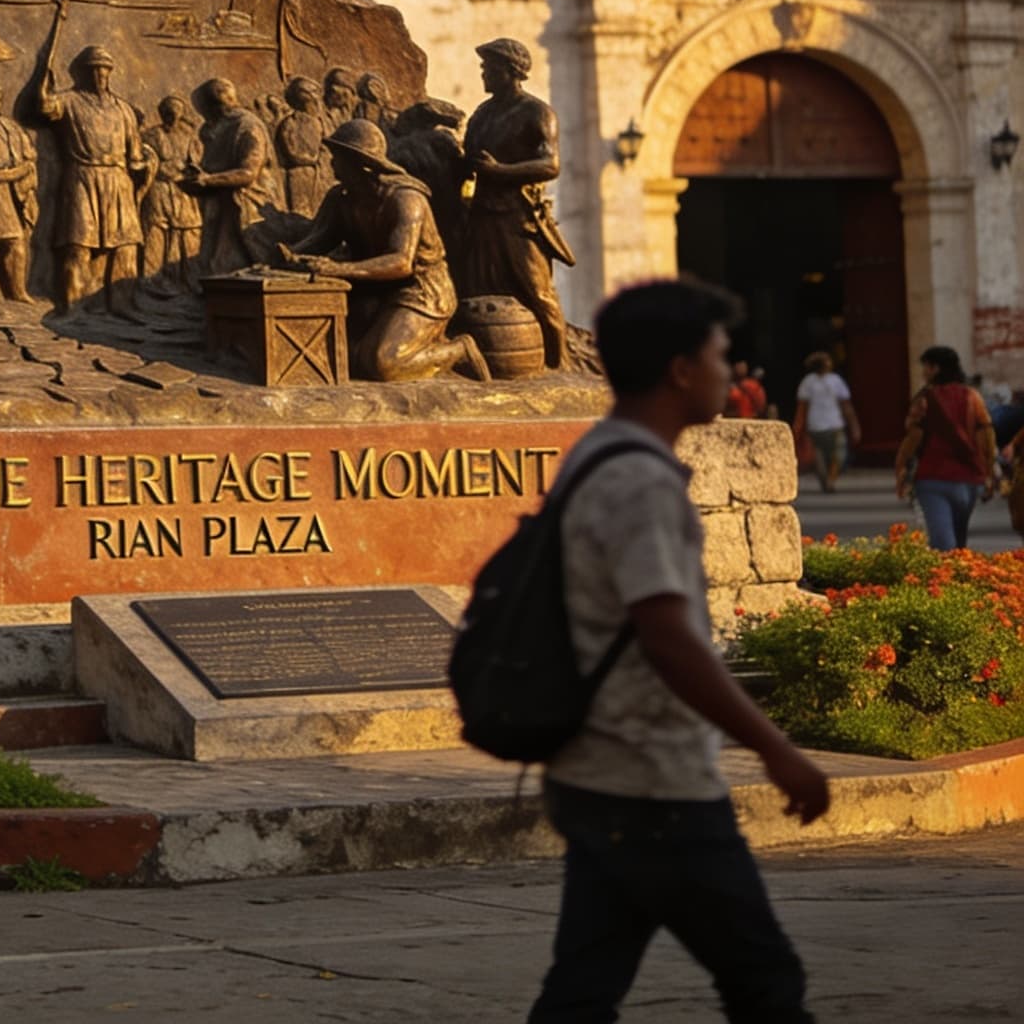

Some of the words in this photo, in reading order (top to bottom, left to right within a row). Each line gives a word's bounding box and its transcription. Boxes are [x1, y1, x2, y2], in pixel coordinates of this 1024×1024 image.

[54, 450, 312, 508] HERITAGE
[331, 447, 561, 500] MOMENT
[87, 517, 183, 560] RIAN
[203, 513, 333, 557] PLAZA
